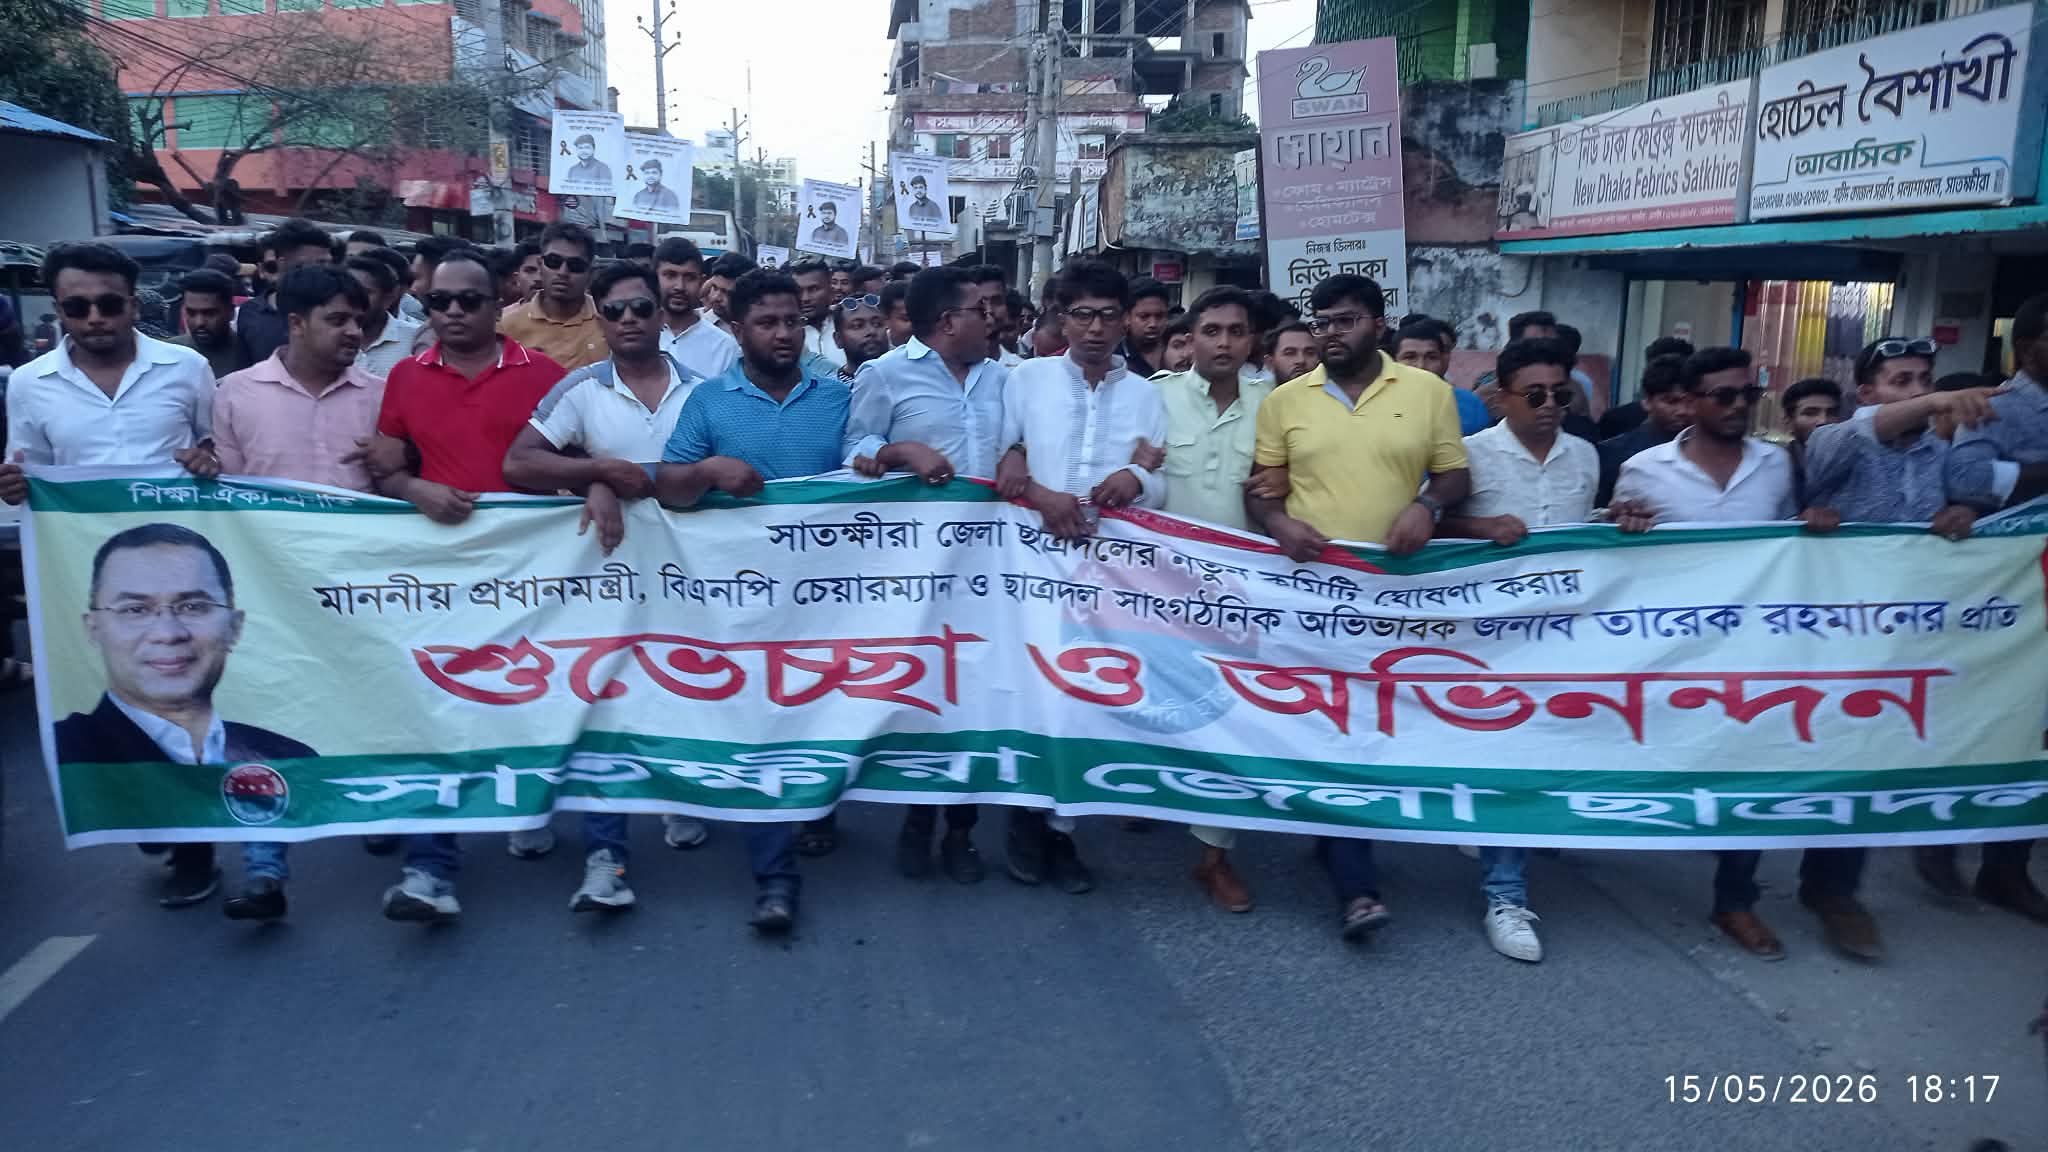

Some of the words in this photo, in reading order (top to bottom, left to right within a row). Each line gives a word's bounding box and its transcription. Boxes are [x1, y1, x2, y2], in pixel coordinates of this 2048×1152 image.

[1294, 95, 1365, 114] SWAN
[1759, 80, 1848, 141] হোটেল
[1858, 32, 2018, 122] বৈশাখী
[1603, 127, 1630, 166] ঢাকা
[1680, 91, 1747, 151] সাতক্ষীরা
[1795, 137, 1918, 175] আবাসিক
[1573, 176, 1597, 207] New
[1598, 171, 1632, 203] Dhaka
[1634, 165, 1679, 199] Febrics
[1681, 154, 1739, 194] Satkhira
[1945, 168, 1991, 194] সাতক্ষীরা
[1288, 258, 1332, 287] নিউ
[766, 512, 924, 552] সাতক্ষীরা
[937, 519, 1007, 548] জেলা
[1375, 582, 1482, 608] ঘোষণা
[1496, 569, 1585, 598] করায়
[312, 574, 457, 616] মাননীয়
[468, 563, 647, 610] প্রধানমন্ত্রী,
[657, 563, 780, 608] বিএনপি
[793, 571, 957, 606] চেয়ারম্যান
[966, 574, 989, 598] ও
[1000, 572, 1103, 611] ছাত্রদল
[1113, 586, 1286, 633] সাংগঠনিক
[1295, 605, 1456, 641] অভিভাবক
[1473, 612, 1583, 641] জনাব
[1593, 603, 1745, 639] তারেক
[1757, 591, 1950, 639] রহমানের
[1960, 595, 2024, 632] প্রতি
[411, 624, 988, 715] শুভেচ্ছা
[1027, 642, 1145, 708] ও
[1203, 646, 1955, 745] অভিনন্দন
[321, 746, 1041, 808] সাতক্ষীরা
[1084, 762, 1506, 823] জেলা
